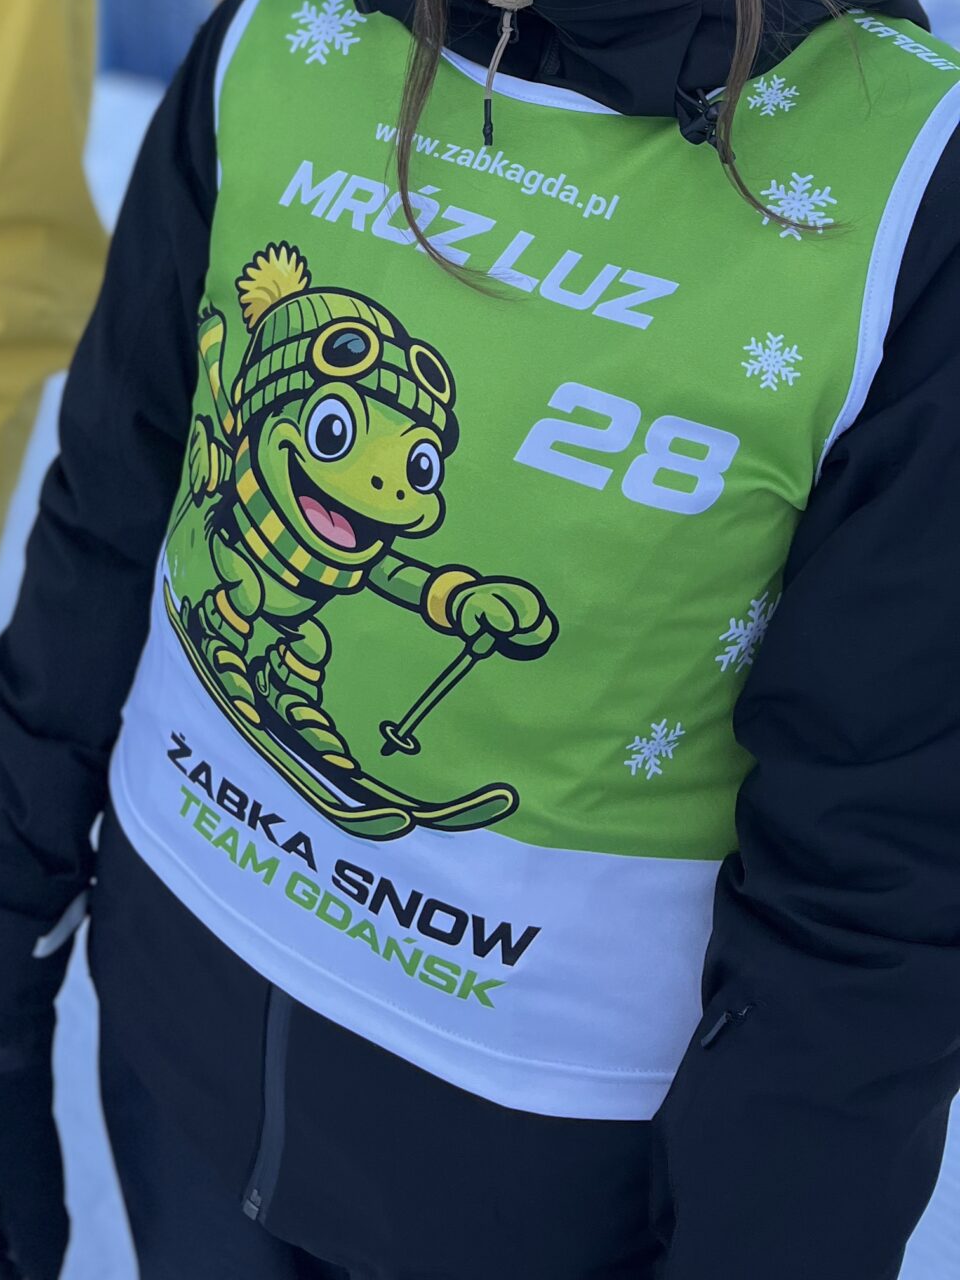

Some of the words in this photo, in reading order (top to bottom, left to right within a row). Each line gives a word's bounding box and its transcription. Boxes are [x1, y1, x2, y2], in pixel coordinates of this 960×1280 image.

[278, 160, 497, 266] MRÓZ
[487, 230, 680, 330] LUZ
[514, 381, 740, 515] 28
[166, 730, 318, 873] ŻABKA
[331, 858, 542, 967] SNOW
[179, 784, 281, 887] TEAM
[285, 871, 508, 1010] GDAŃSK
